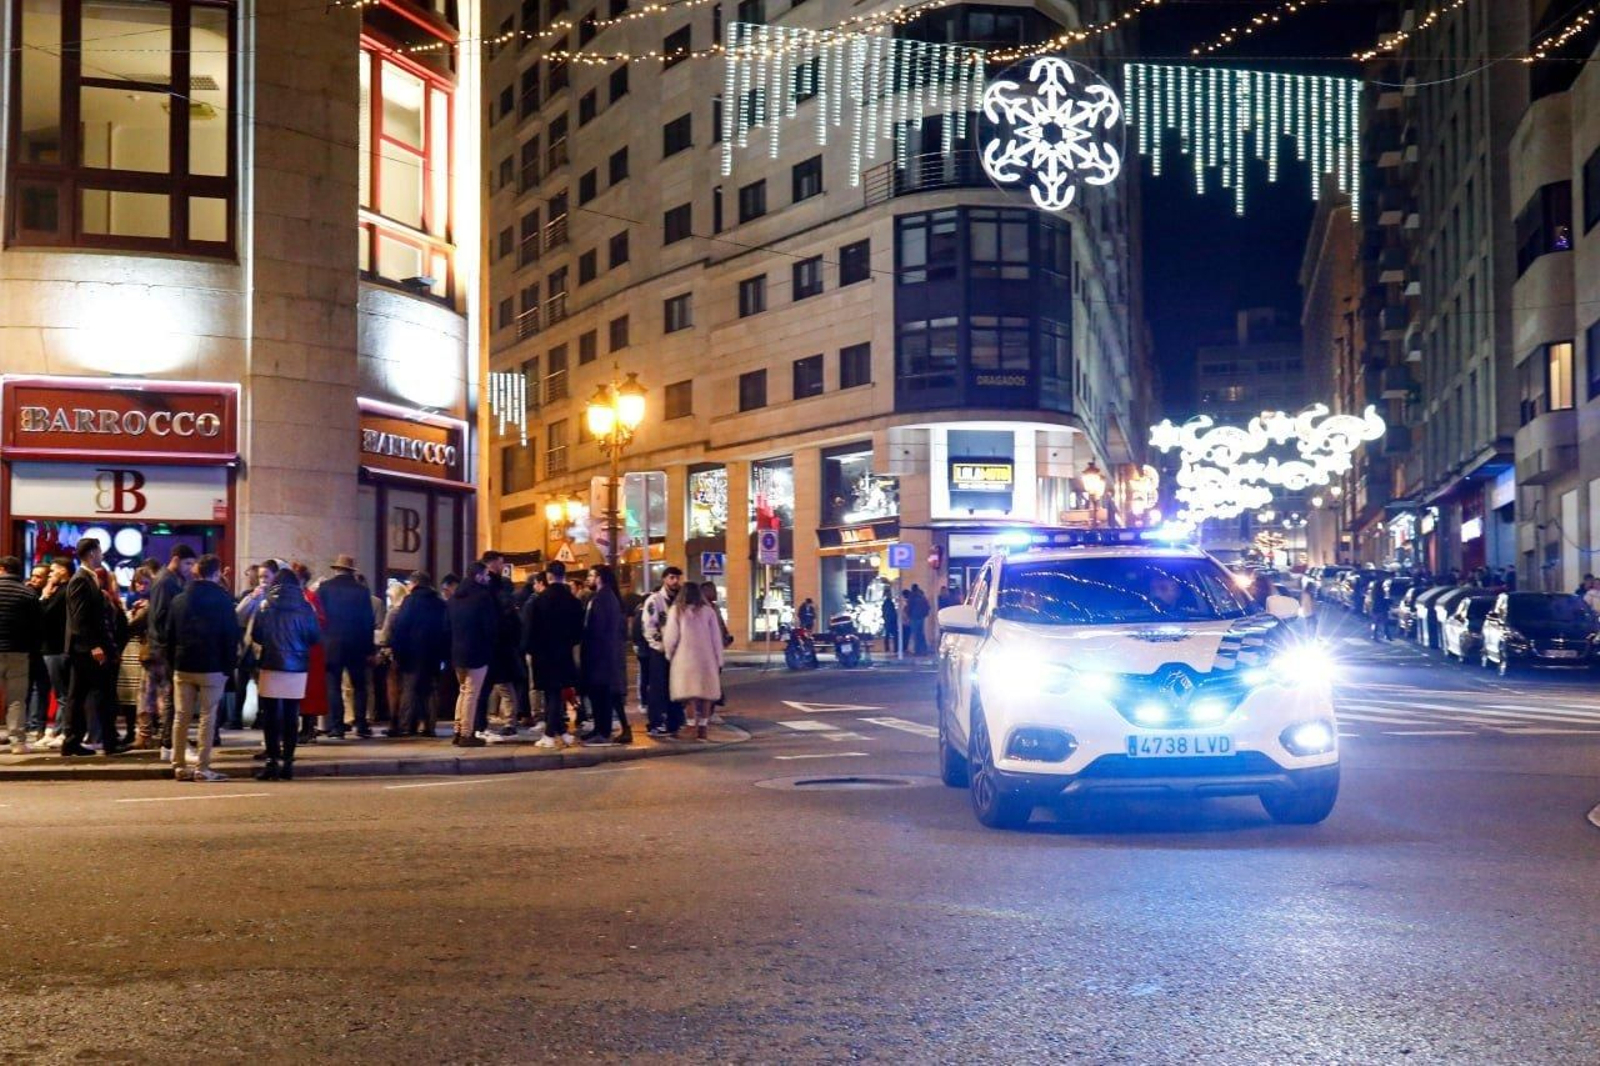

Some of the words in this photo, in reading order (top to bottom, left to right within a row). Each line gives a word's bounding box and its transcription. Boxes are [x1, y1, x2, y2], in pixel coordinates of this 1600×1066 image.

[20, 405, 221, 437] BARROCCO
[361, 427, 456, 467] BARROCCO
[894, 546, 910, 567] P
[1141, 736, 1188, 754] 4738
[1194, 736, 1230, 754] LVD
